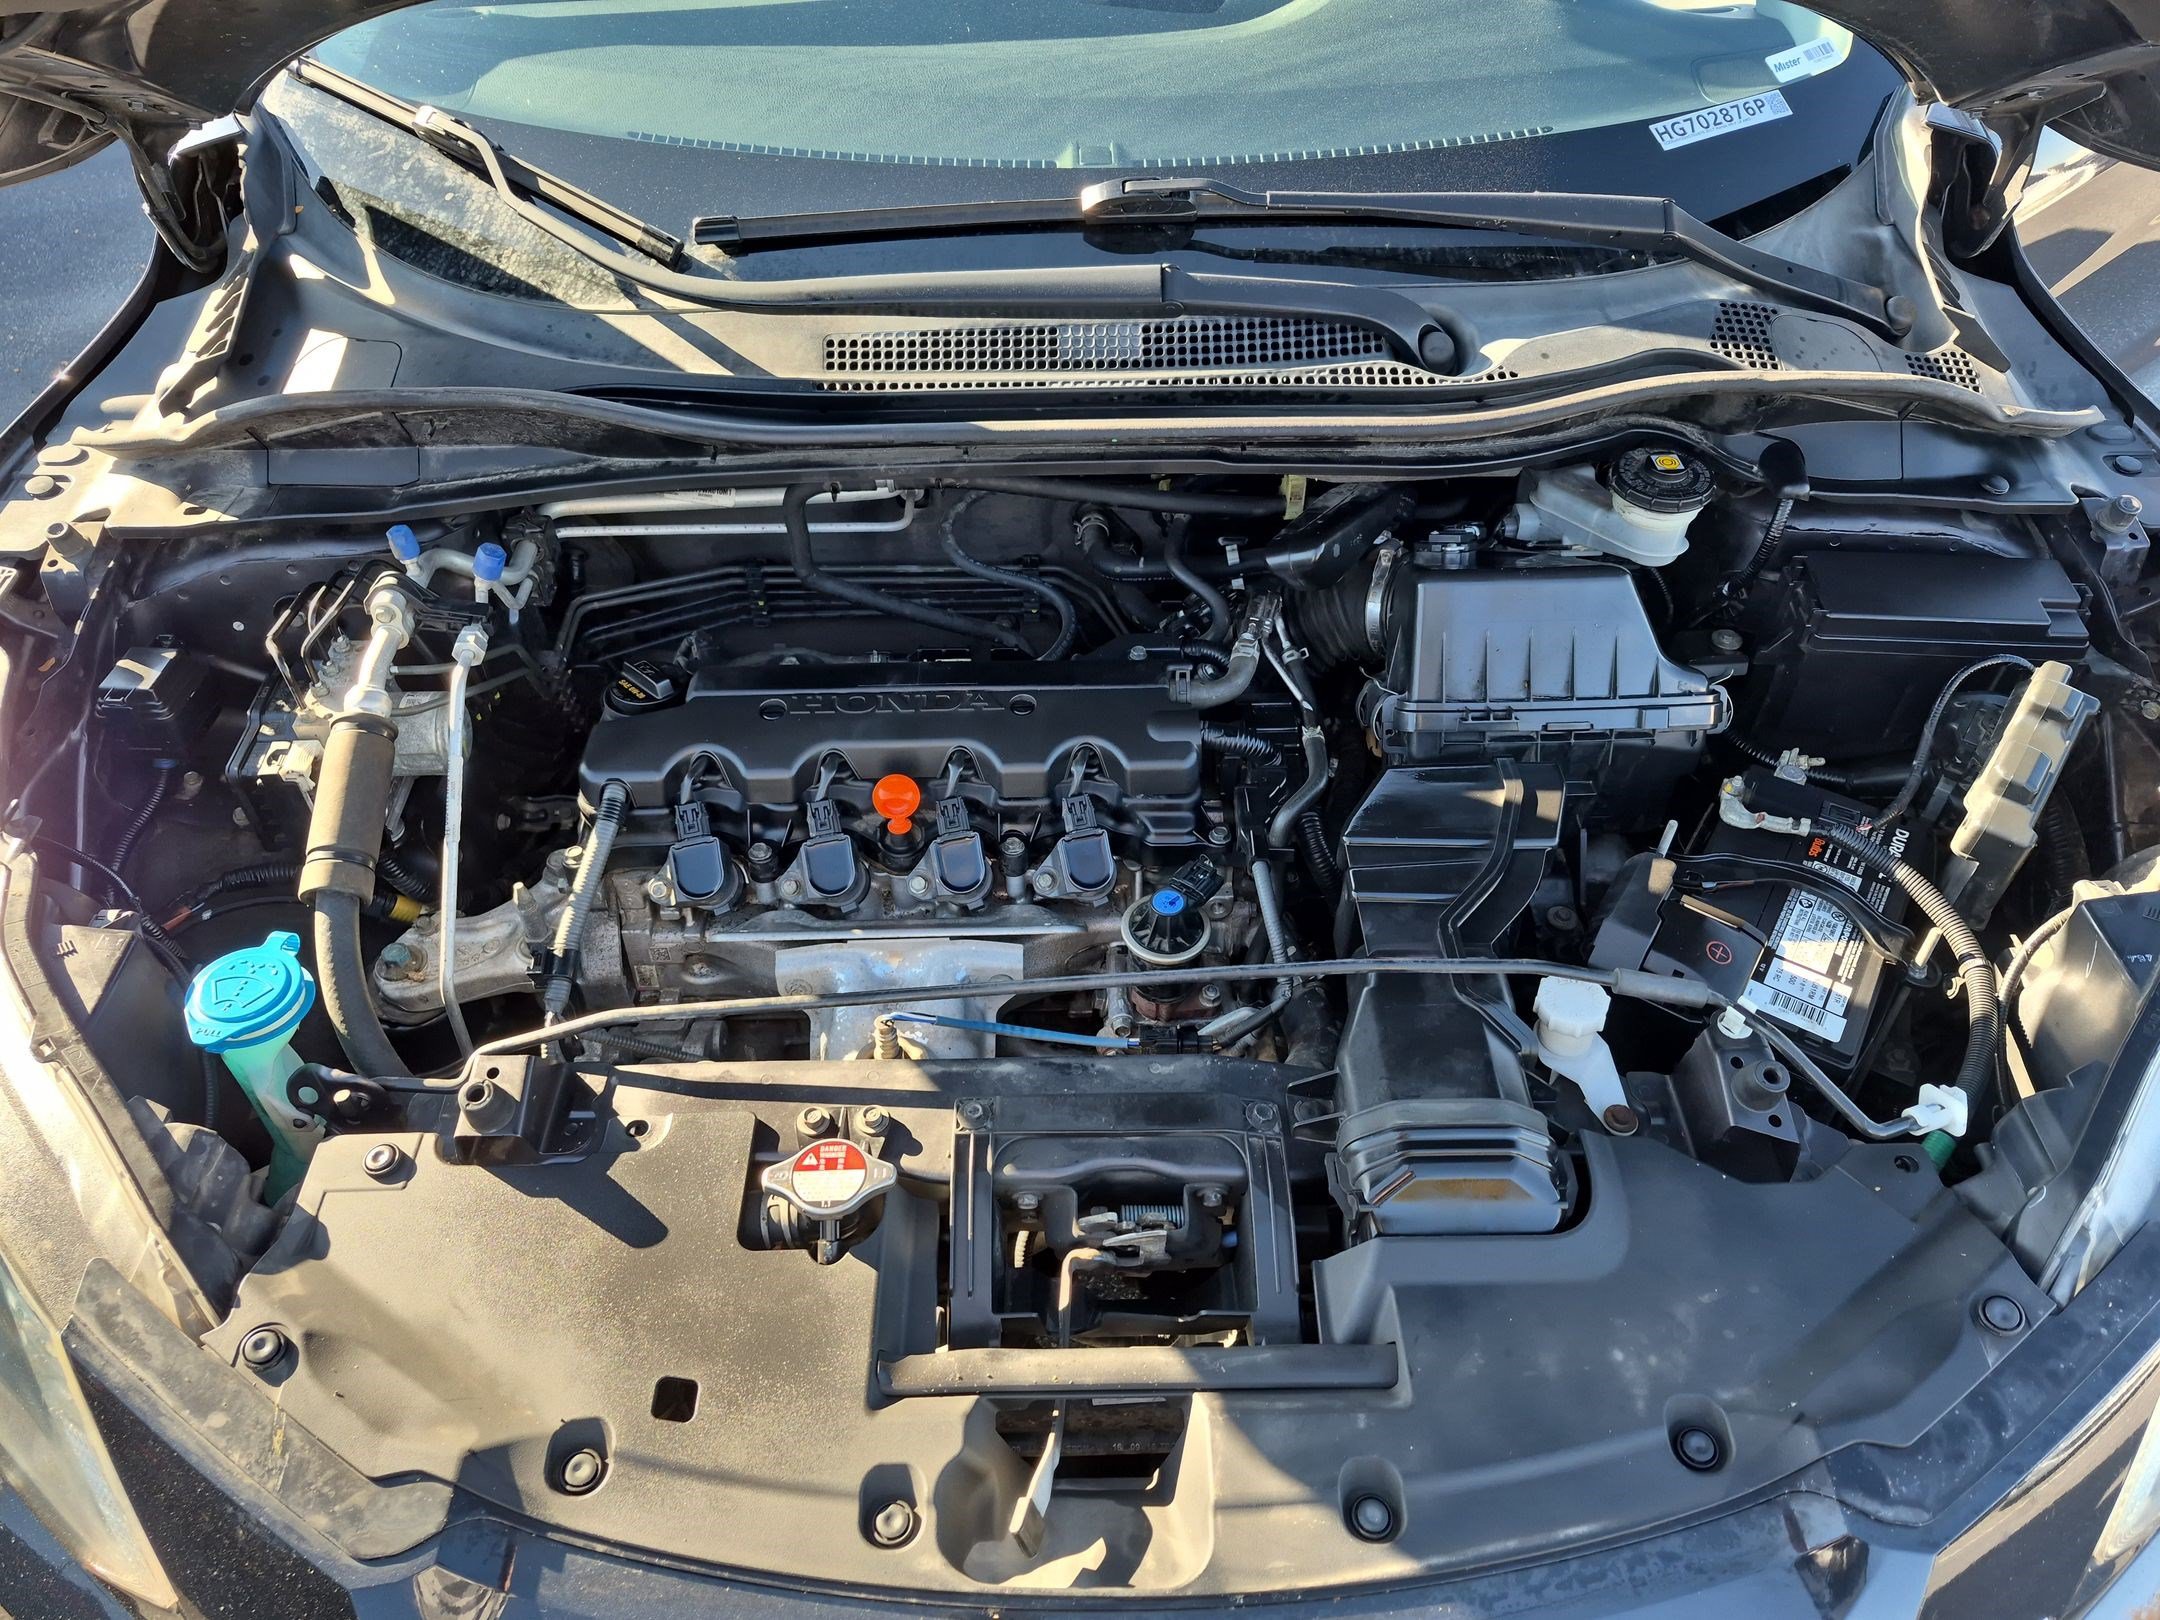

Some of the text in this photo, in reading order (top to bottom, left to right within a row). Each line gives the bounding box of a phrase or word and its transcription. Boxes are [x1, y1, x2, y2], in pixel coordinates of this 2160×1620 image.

[1773, 56, 1801, 72] Mister
[1654, 98, 1766, 142] HG702876P
[789, 693, 1005, 715] HONDA
[195, 1027, 222, 1038] PULL
